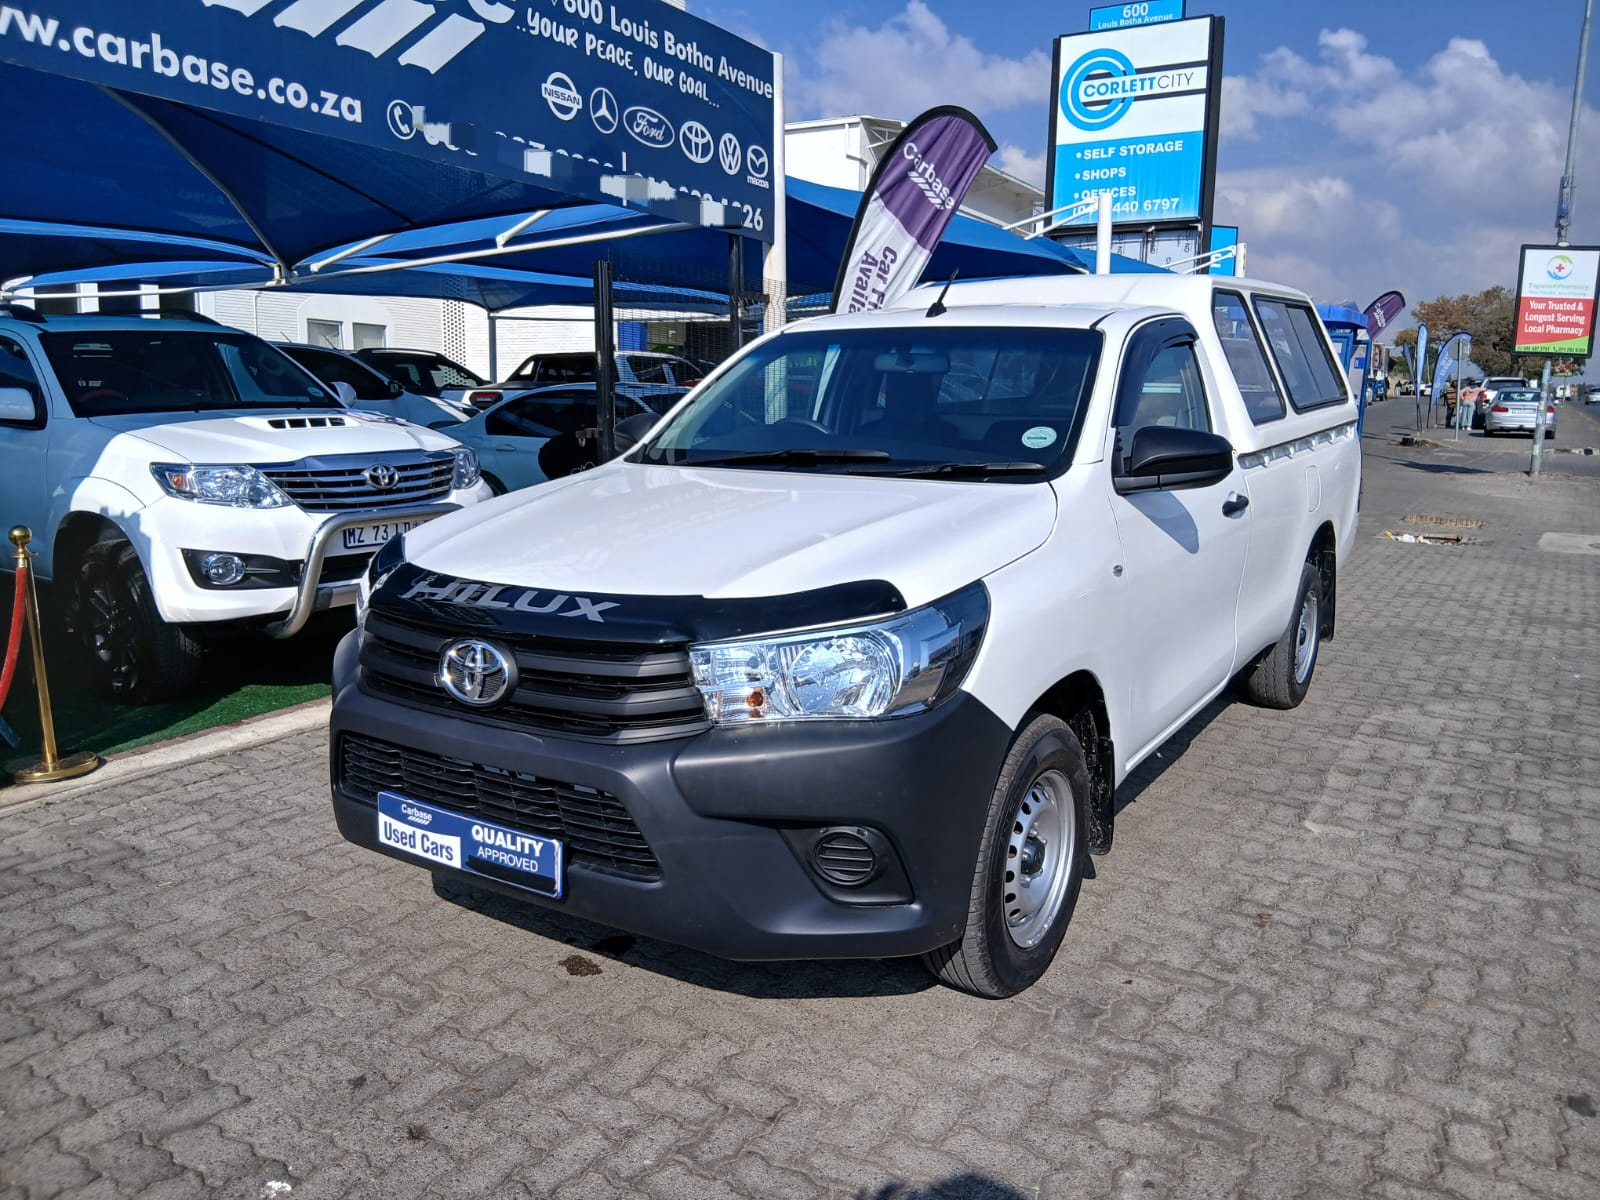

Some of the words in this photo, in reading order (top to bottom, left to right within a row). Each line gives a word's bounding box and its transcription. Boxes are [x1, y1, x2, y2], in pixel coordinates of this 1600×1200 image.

[1098, 21, 1119, 29] Louis
[1120, 17, 1143, 26] Botha
[1144, 13, 1174, 23] Avenue
[1122, 3, 1149, 18] 600
[610, 5, 659, 49] Louis
[664, 30, 714, 73] Botha
[718, 56, 773, 98] Avenue
[0, 6, 363, 123] w.carbase.co.za
[643, 56, 675, 86] OUR
[678, 71, 720, 108] GOAL...
[543, 85, 581, 106] NISSAN
[633, 112, 665, 141] Ford
[1083, 147, 1116, 160] SELF
[1119, 140, 1184, 157] STORAGE
[903, 142, 956, 210] Carbase
[1082, 167, 1127, 181] SHOPS
[1112, 200, 1139, 212] 440
[1143, 198, 1180, 211] 6797
[876, 246, 898, 285] Car
[867, 288, 886, 312] Fi
[1530, 300, 1546, 310] Your
[1548, 300, 1577, 310] Trusted
[1577, 302, 1584, 311] &
[1525, 312, 1555, 323] Longest
[1556, 313, 1585, 325] Serving
[1524, 324, 1545, 333] Local
[1546, 325, 1584, 336] Pharmacy
[372, 524, 389, 541] 73
[401, 580, 622, 623] HILUX
[401, 804, 433, 821] Carbase
[384, 820, 417, 849] Used
[420, 830, 454, 862] Cars
[471, 824, 544, 857] QUALITY
[477, 845, 539, 873] APPROVED
